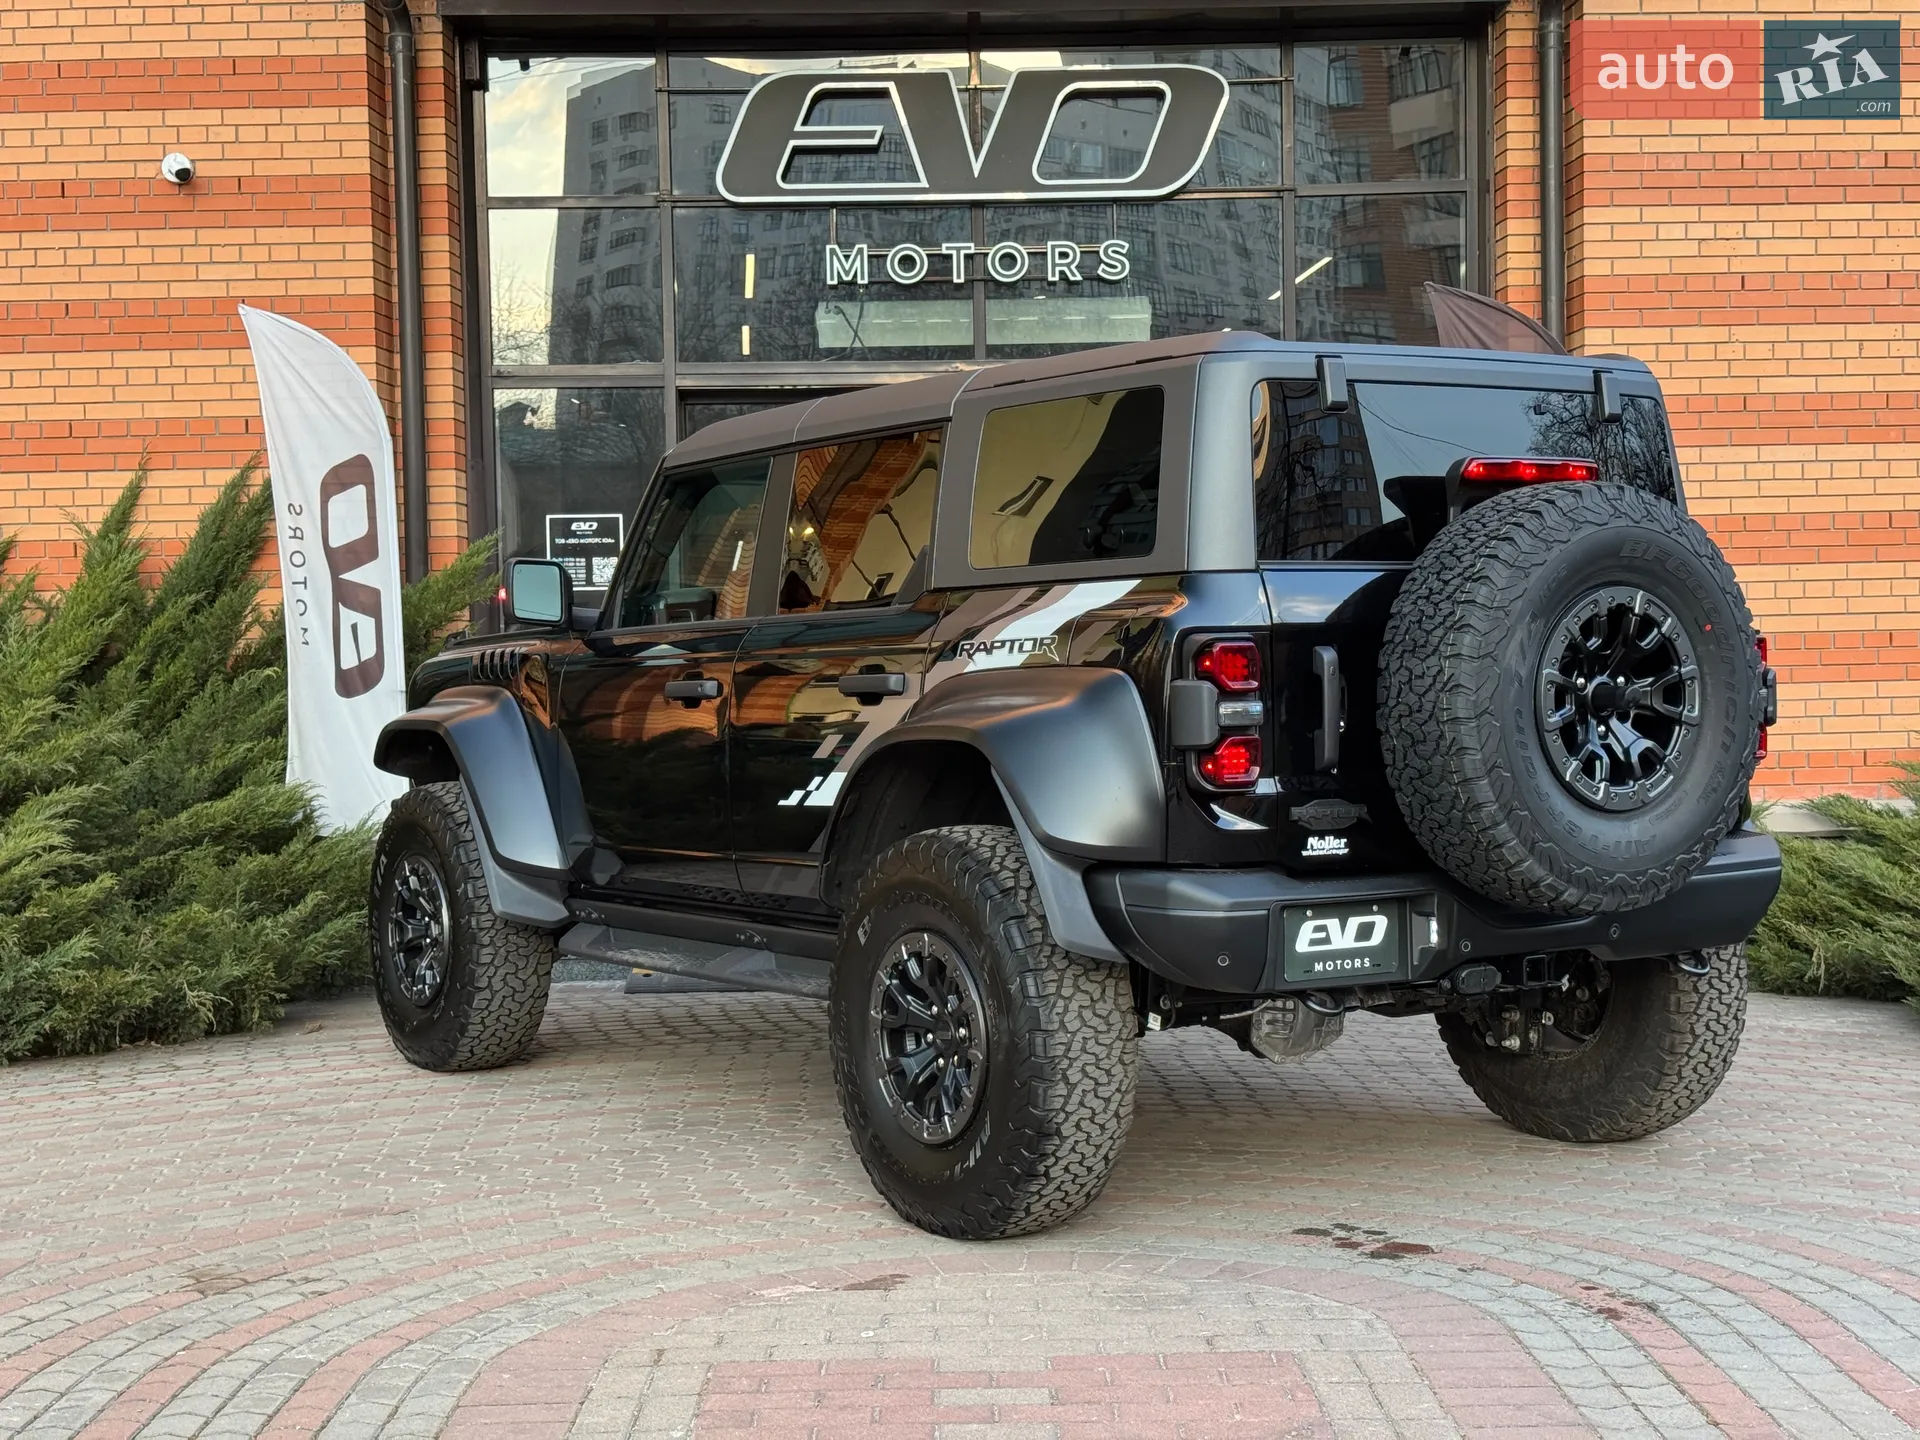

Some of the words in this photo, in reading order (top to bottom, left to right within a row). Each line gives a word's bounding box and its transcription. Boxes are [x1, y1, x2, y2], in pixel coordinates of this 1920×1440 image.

[715, 64, 1230, 204] EVO
[825, 239, 1131, 286] MOTORS
[958, 635, 1060, 666] RAPTOR
[1307, 836, 1347, 849] Noller
[1295, 914, 1388, 953] EVO
[1314, 957, 1371, 972] MOTORS
